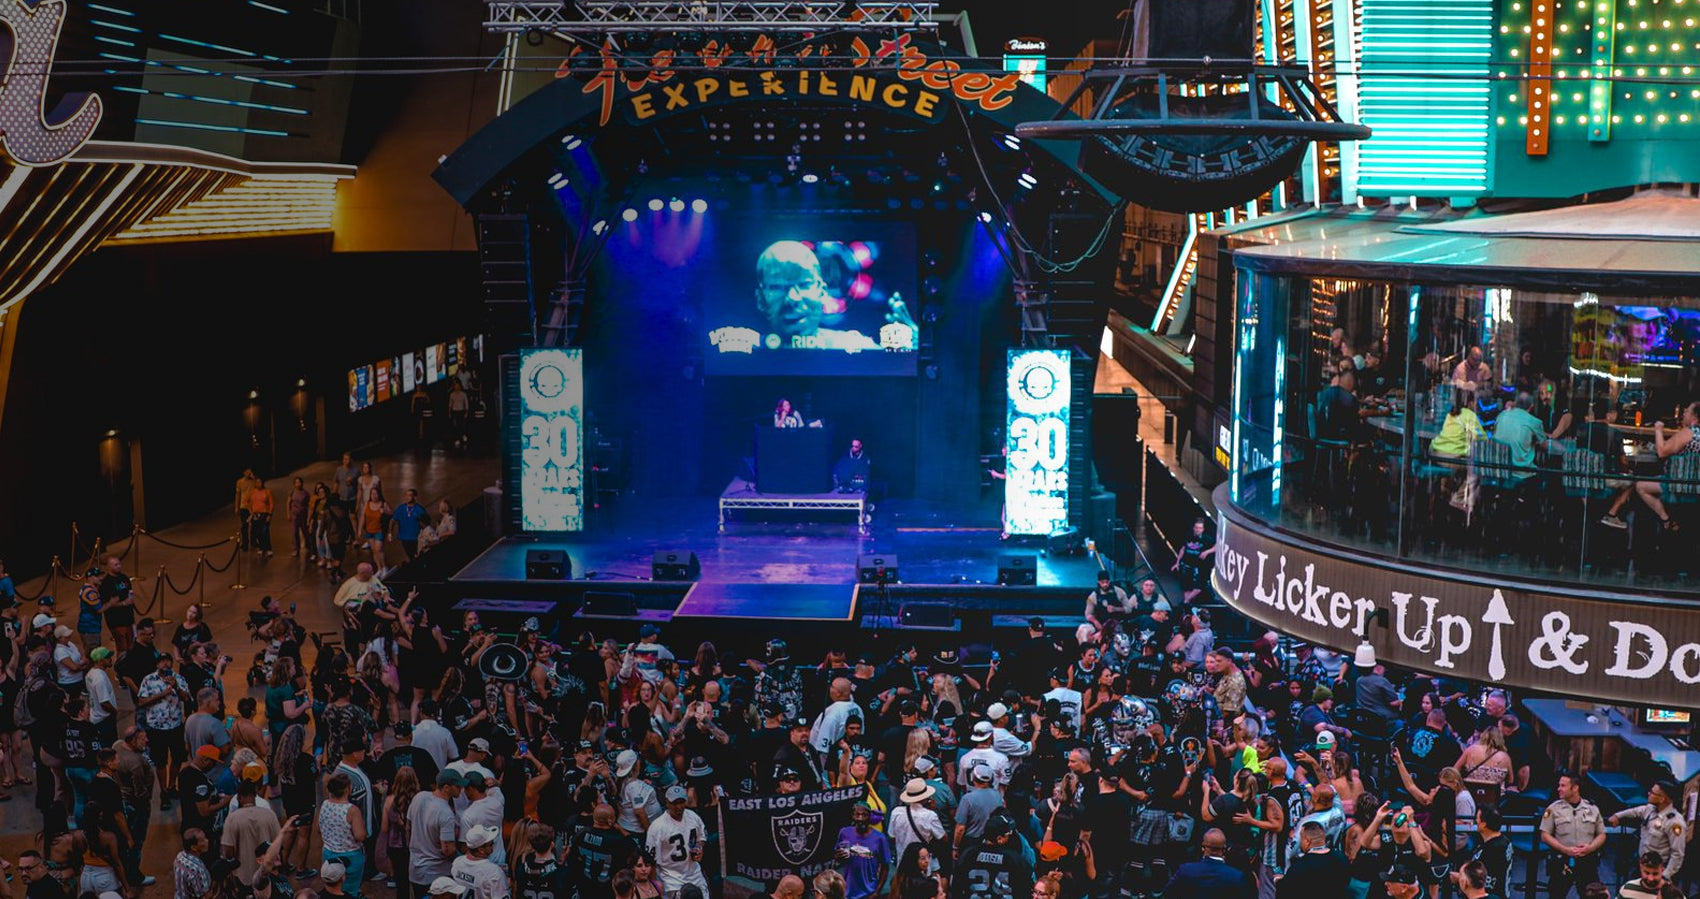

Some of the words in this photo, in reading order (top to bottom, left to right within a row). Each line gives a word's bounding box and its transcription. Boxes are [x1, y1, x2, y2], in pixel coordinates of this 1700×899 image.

[1008, 39, 1046, 50] Binion's
[630, 69, 939, 120] EXPERIENCE
[522, 415, 579, 468] 30
[1010, 416, 1067, 470] 30
[1253, 550, 1375, 637] Licker
[1391, 591, 1473, 669] Up
[1528, 610, 1590, 675] &
[729, 799, 762, 811] EAST
[768, 796, 796, 808] LOS
[801, 786, 864, 806] ANGELES
[777, 816, 818, 827] RAIDERS
[668, 827, 698, 862] 34
[577, 846, 613, 883] 77
